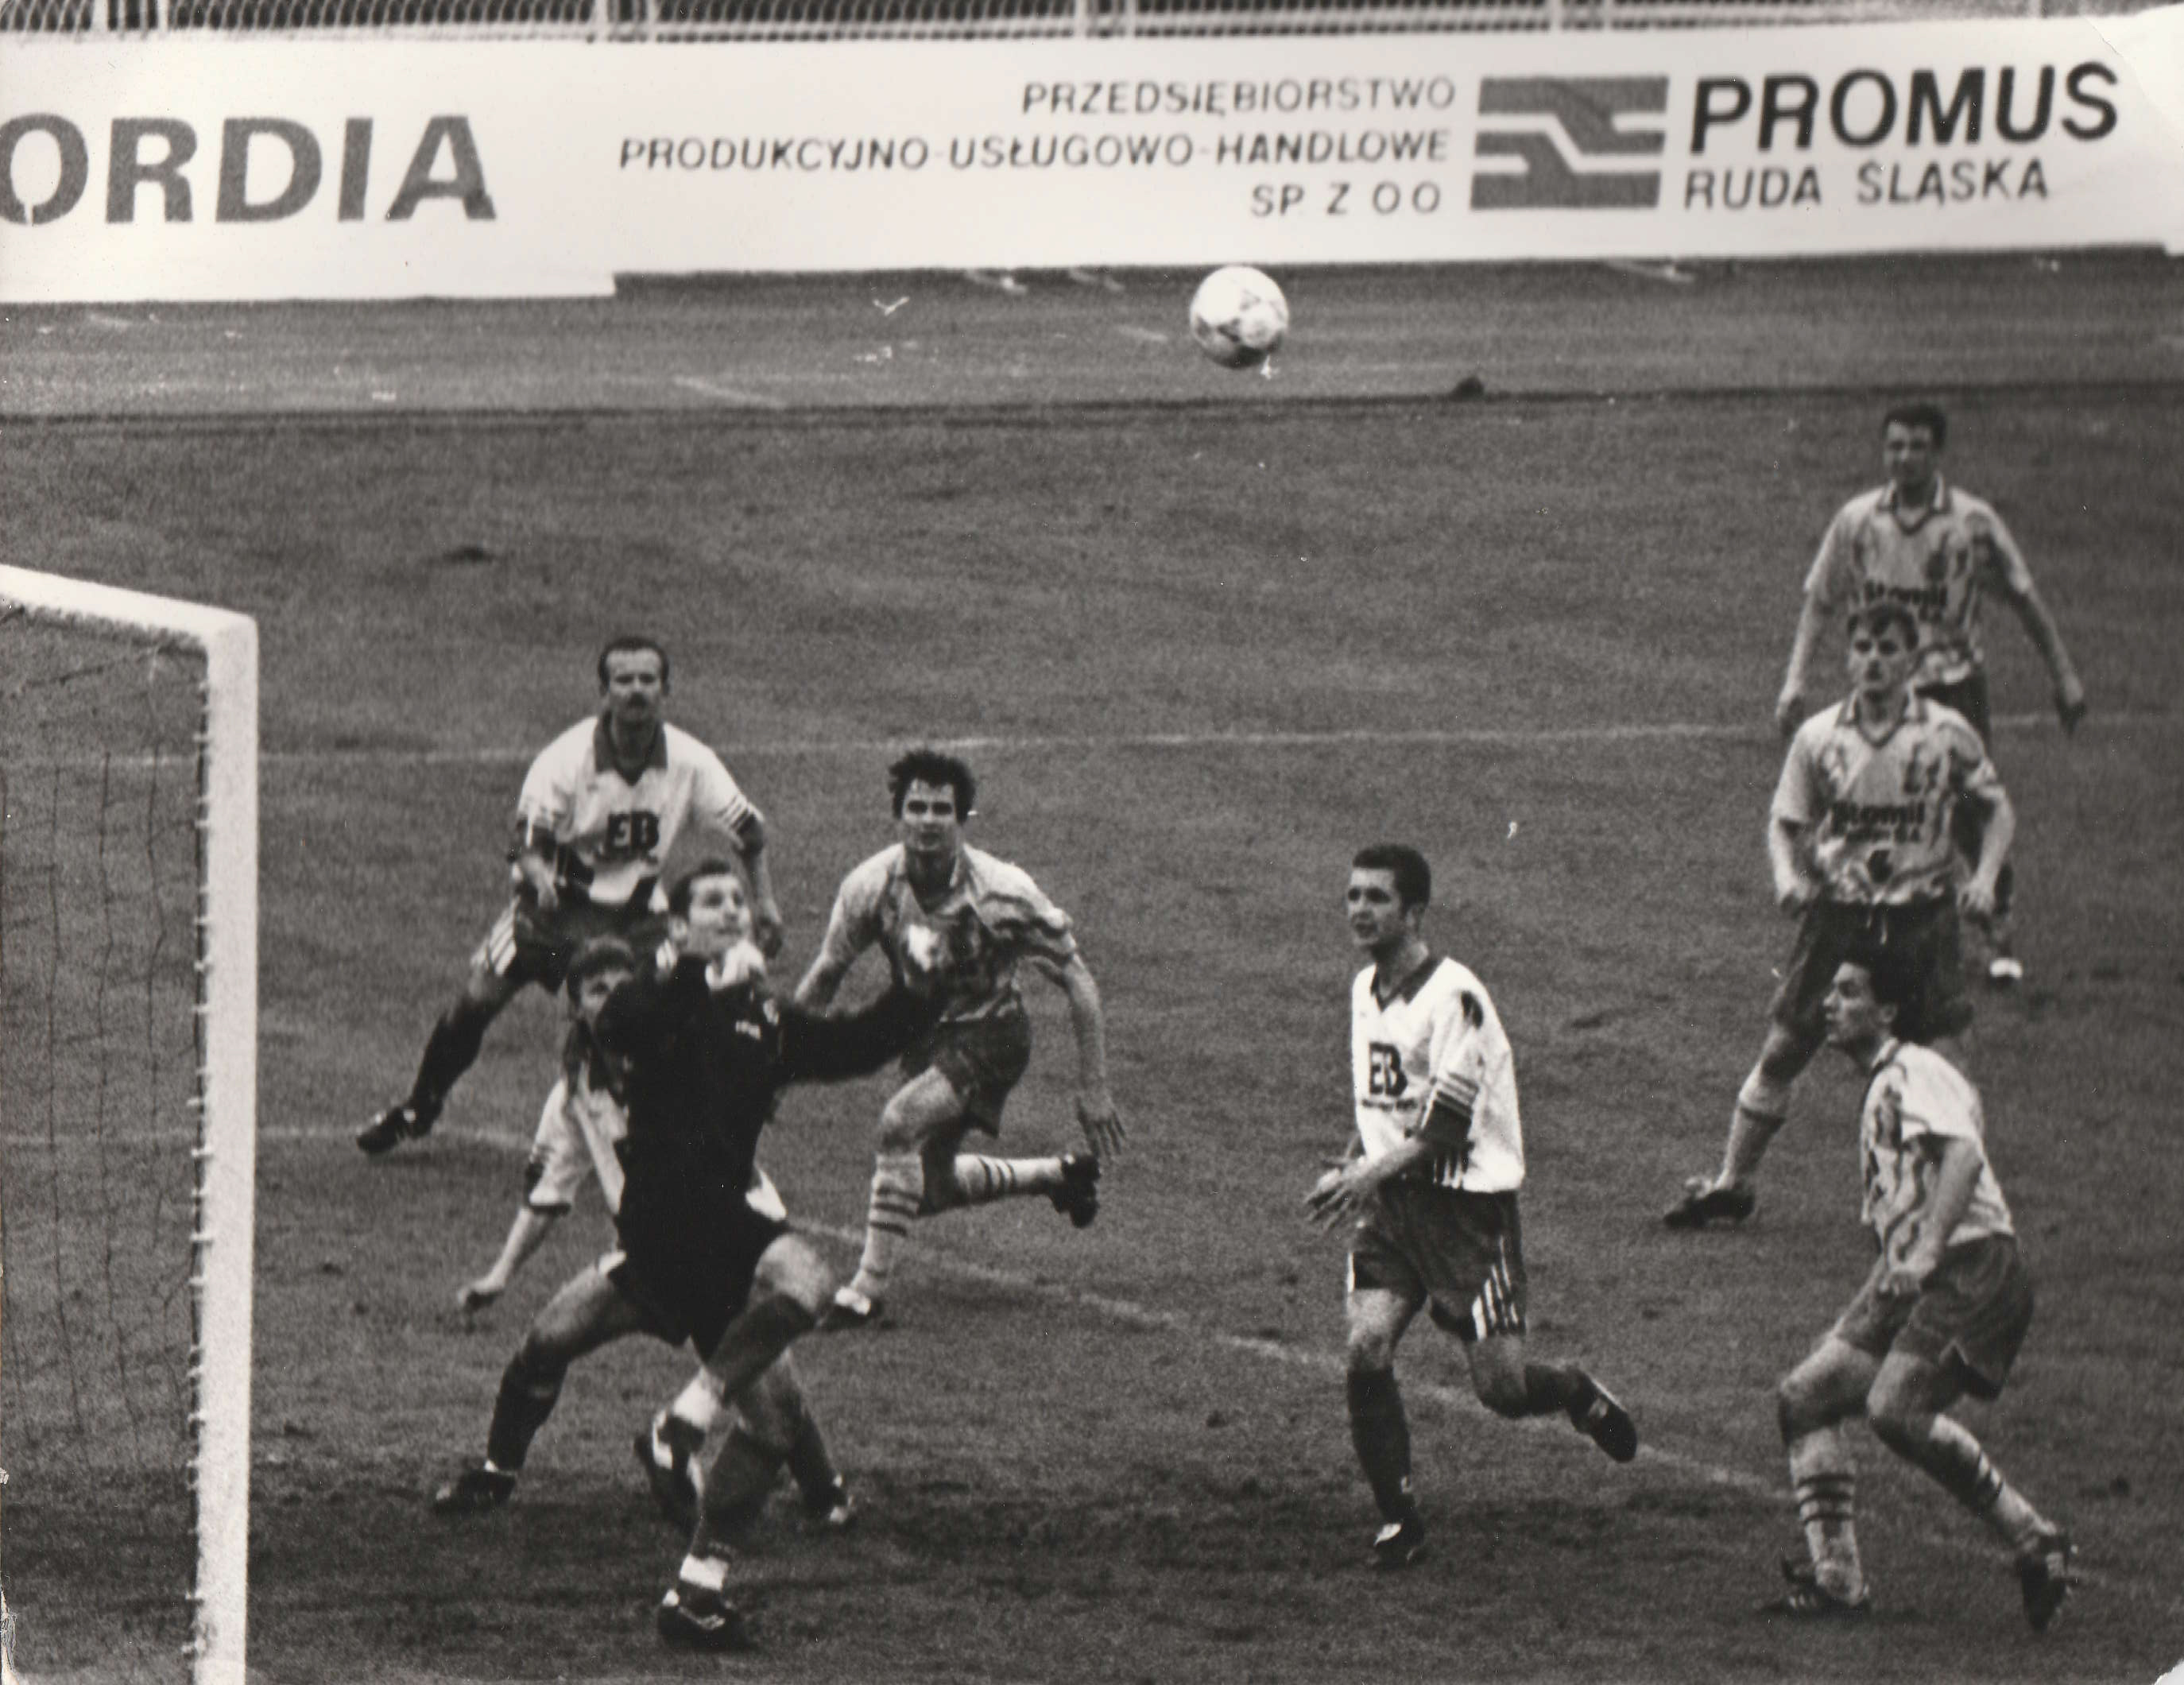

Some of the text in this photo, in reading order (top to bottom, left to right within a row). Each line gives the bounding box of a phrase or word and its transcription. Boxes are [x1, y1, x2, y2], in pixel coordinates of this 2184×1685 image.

[1021, 76, 1457, 118] PRZEDSIĘBIORSTWO
[1689, 60, 2119, 156] PROMUS
[0, 113, 497, 225] ORDIA
[1216, 127, 1450, 165] HANDLOWE
[1250, 182, 1305, 218] SP
[1326, 181, 1351, 216] Z
[1683, 163, 1822, 211] RUDA
[1369, 1040, 1408, 1097] EB
